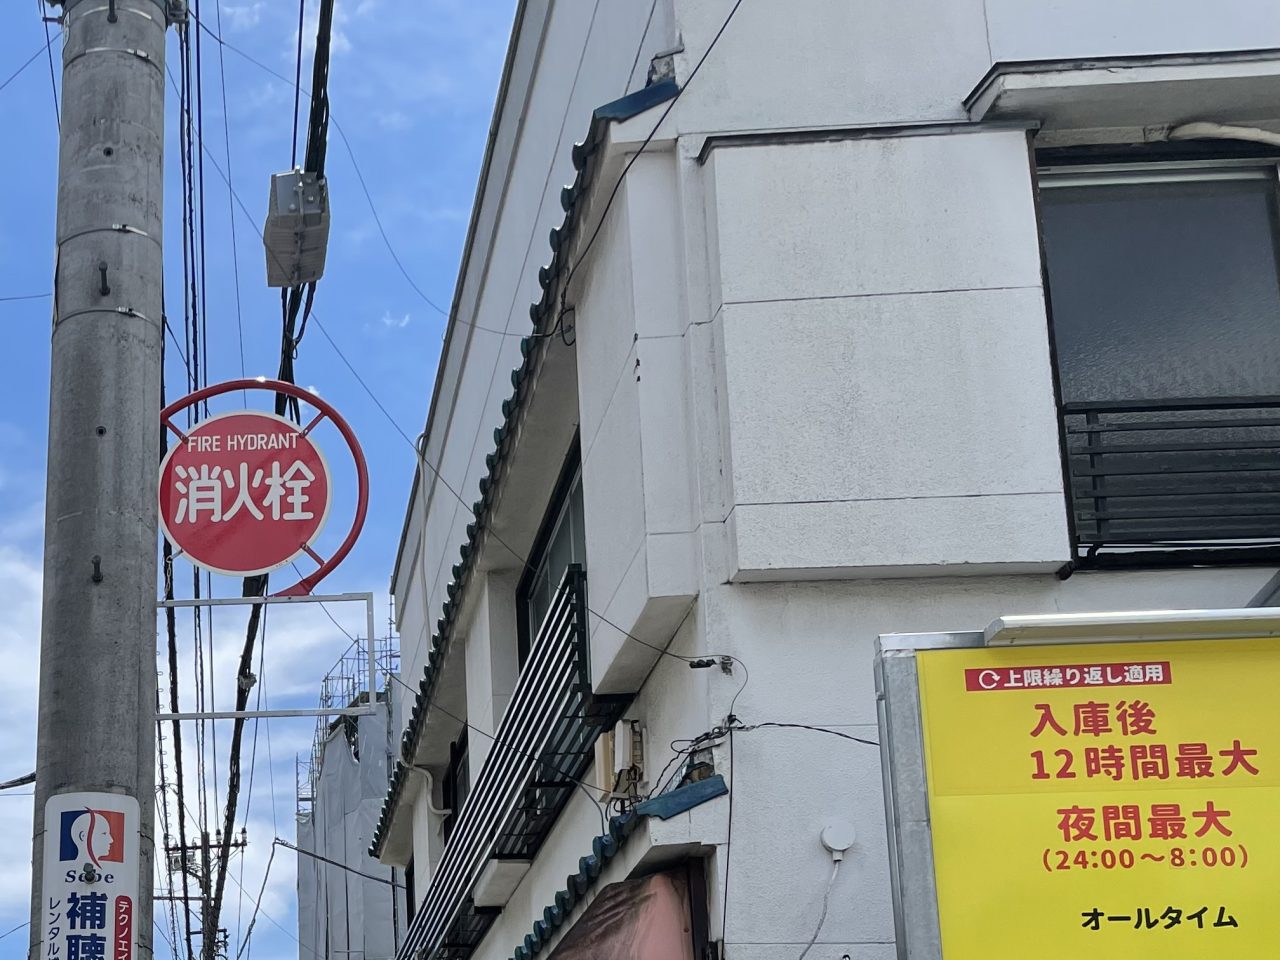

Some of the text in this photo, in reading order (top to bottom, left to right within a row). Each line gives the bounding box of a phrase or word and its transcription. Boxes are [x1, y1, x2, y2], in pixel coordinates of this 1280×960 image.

[187, 432, 300, 453] FIRE HYDRANT
[174, 459, 316, 524] 消火栓
[1003, 664, 1164, 688] 上限繰り返し適用
[1029, 700, 1158, 738] 入庫後
[1029, 739, 1260, 782] 12時間最大
[1055, 800, 1234, 843] 夜間最大
[1080, 906, 1239, 931] オールタイム
